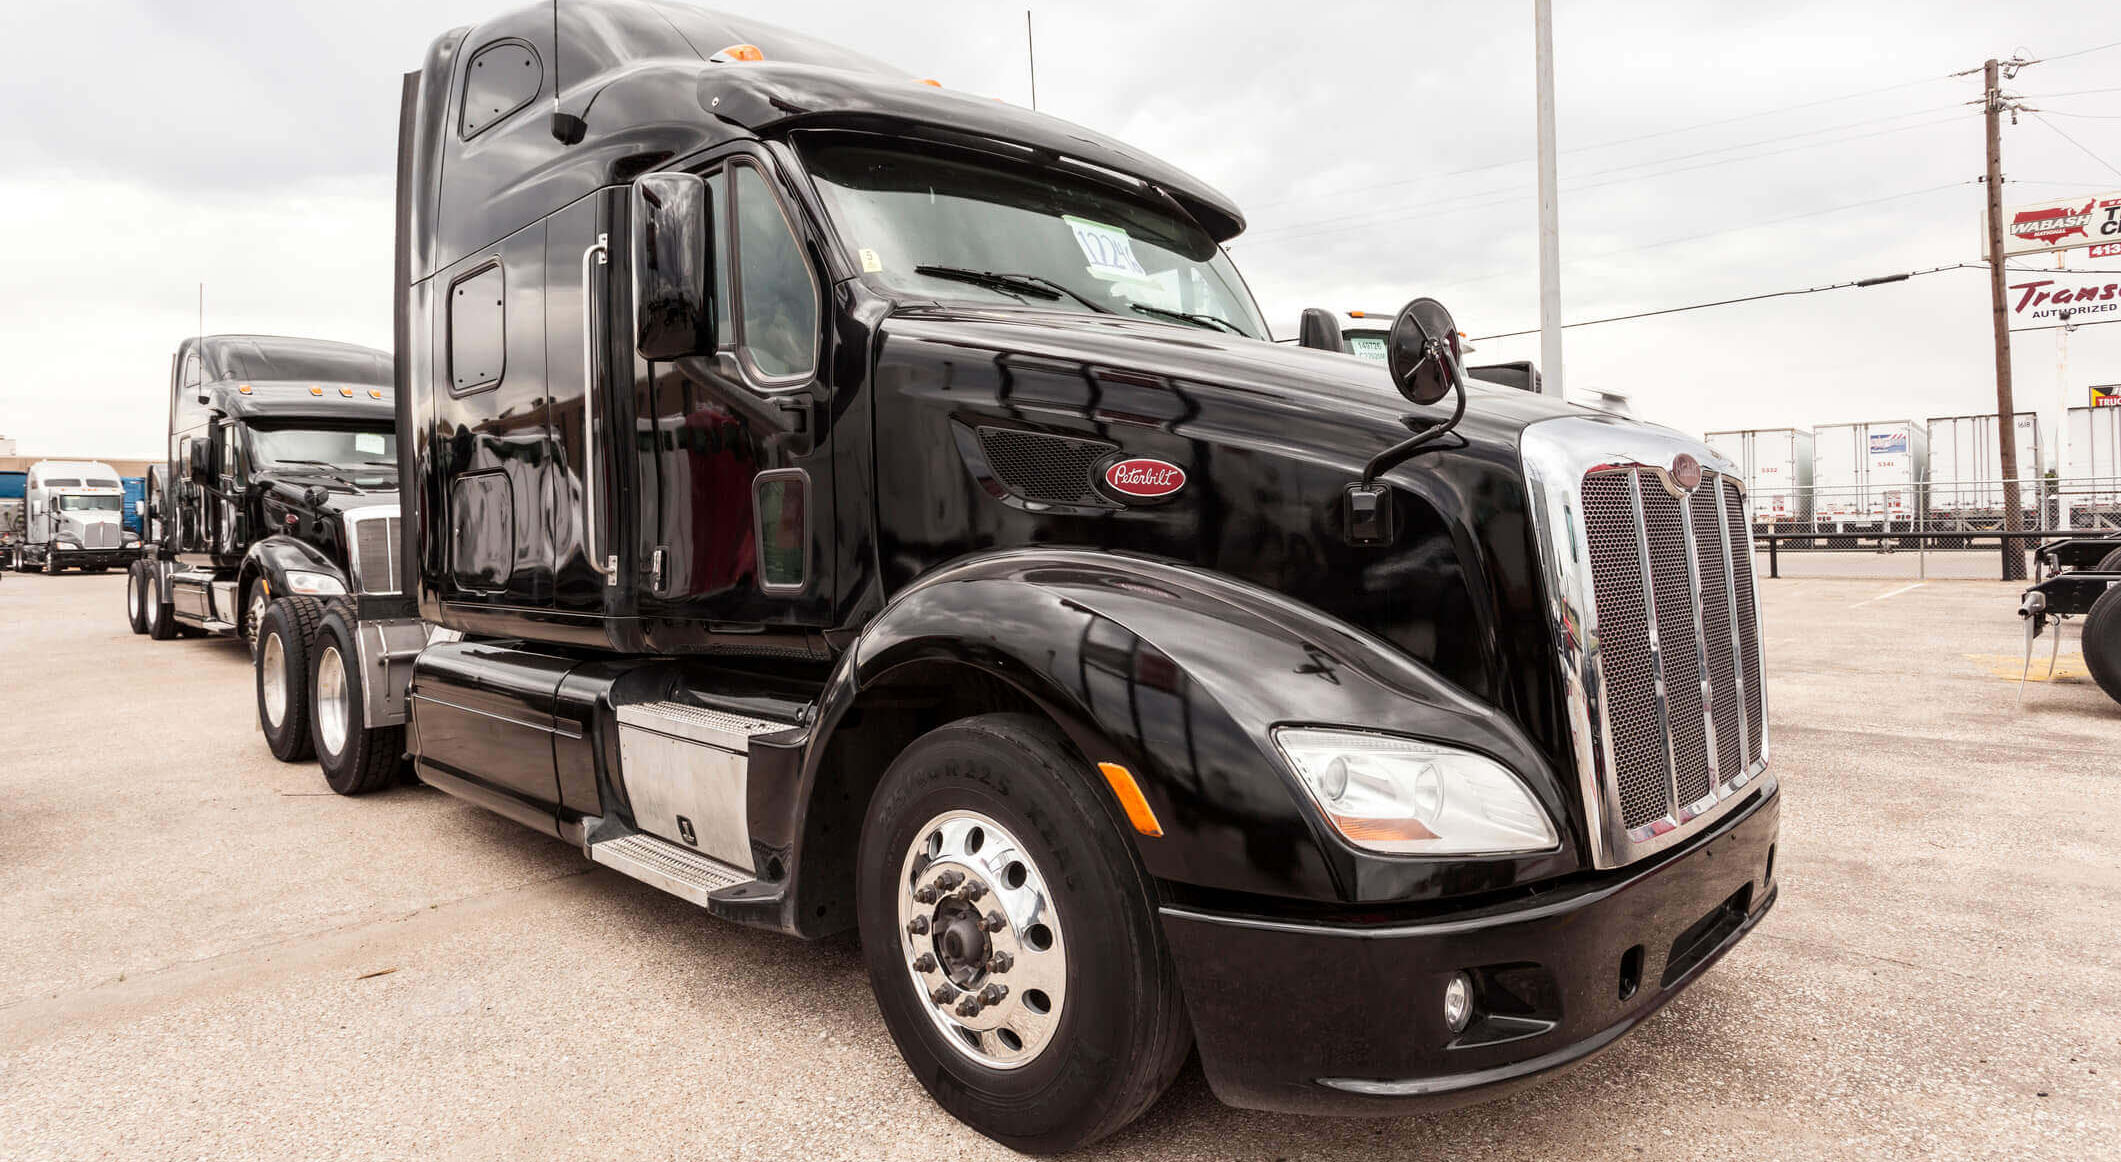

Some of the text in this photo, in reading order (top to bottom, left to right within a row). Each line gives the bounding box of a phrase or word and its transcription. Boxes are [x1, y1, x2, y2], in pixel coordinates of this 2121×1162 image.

[2011, 214, 2091, 233] WABASH
[2034, 228, 2066, 237] NATIONAL
[2008, 280, 2121, 313] Trans
[1114, 465, 1178, 485] Peterbilt
